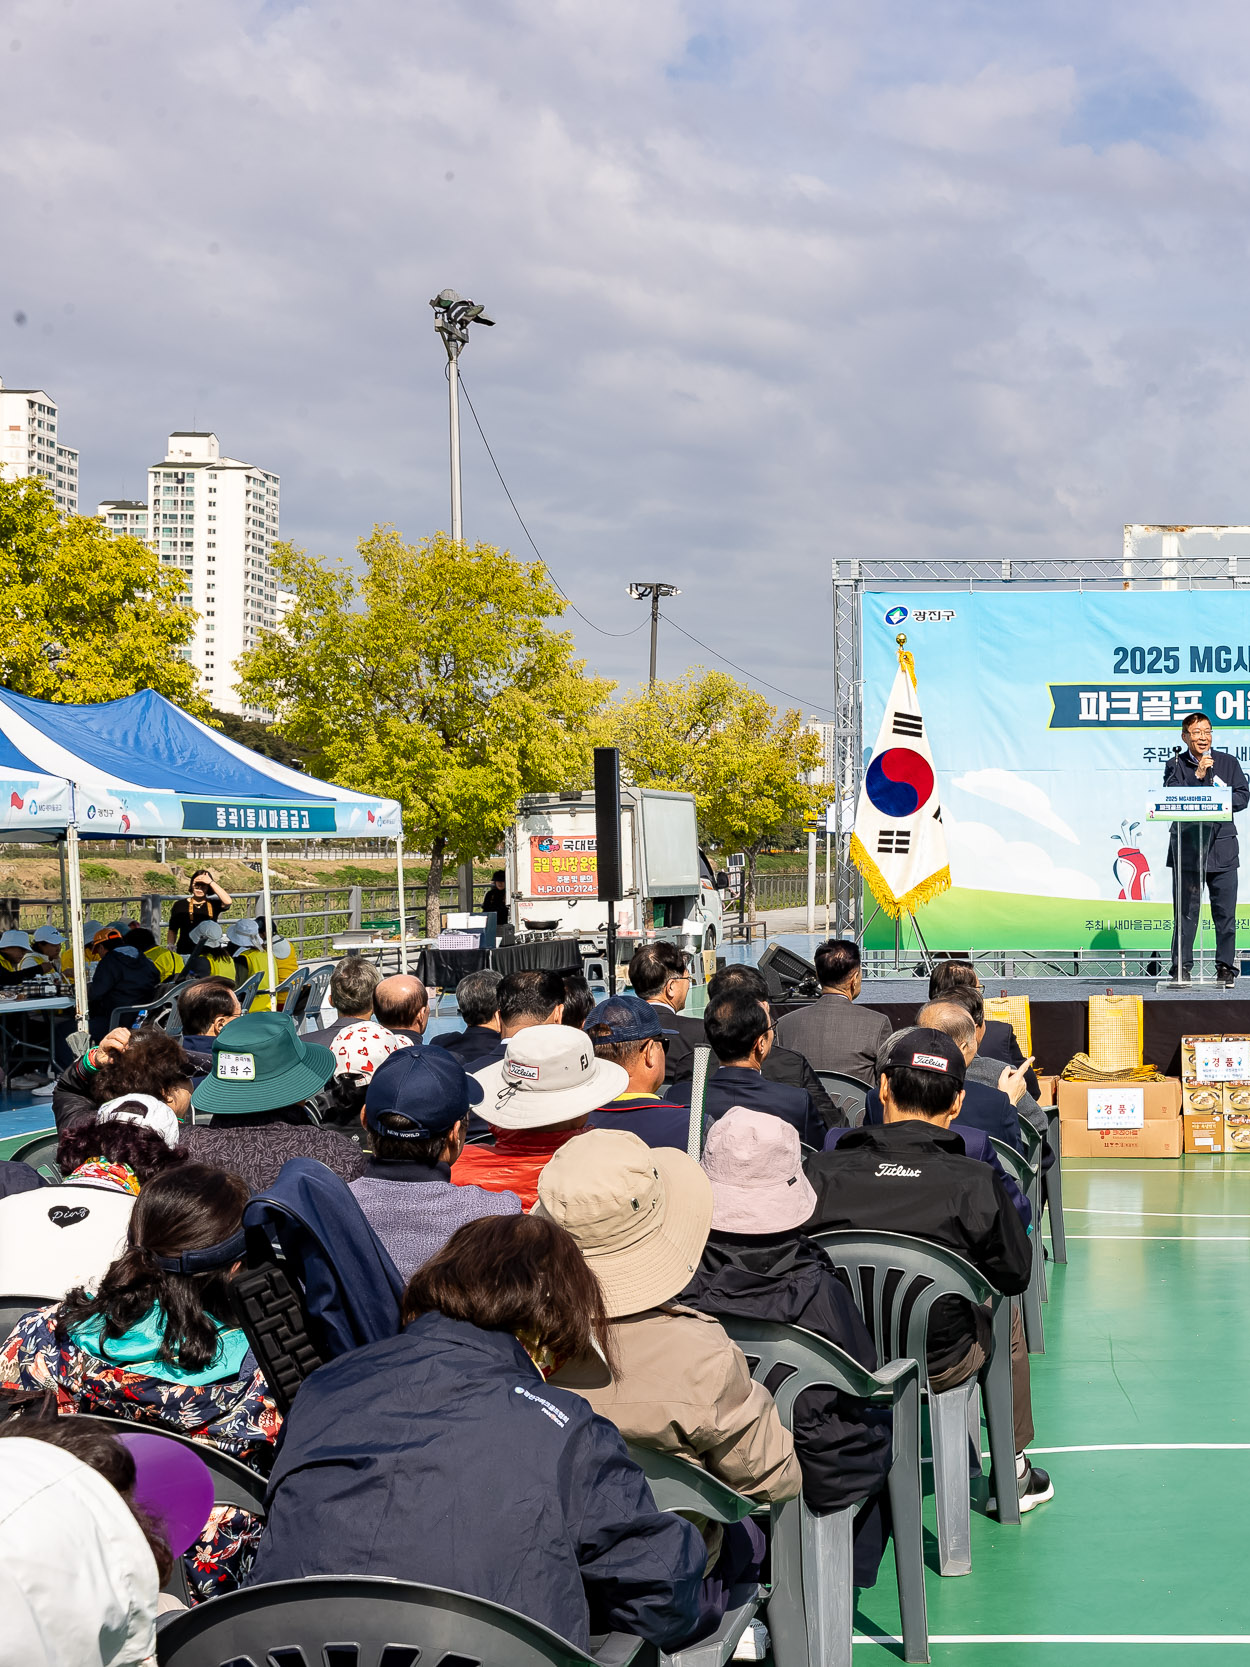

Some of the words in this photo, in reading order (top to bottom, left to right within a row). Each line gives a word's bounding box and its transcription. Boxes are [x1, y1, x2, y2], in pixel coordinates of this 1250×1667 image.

[912, 610, 955, 622] 광진구
[1112, 646, 1180, 675] 2025
[1078, 690, 1203, 721] 파크골프
[216, 806, 311, 830] 중곡1동새마을금고
[533, 856, 551, 873] 금일
[551, 856, 579, 873] 행사장
[557, 875, 570, 884] 주문
[1085, 920, 1104, 931] 주최
[579, 1053, 589, 1071] FJ
[913, 1055, 946, 1069] Titleist
[511, 1064, 537, 1078] Titleist
[387, 1129, 399, 1137] NEW
[874, 1163, 922, 1178] Titleist
[51, 1208, 88, 1222] Ping
